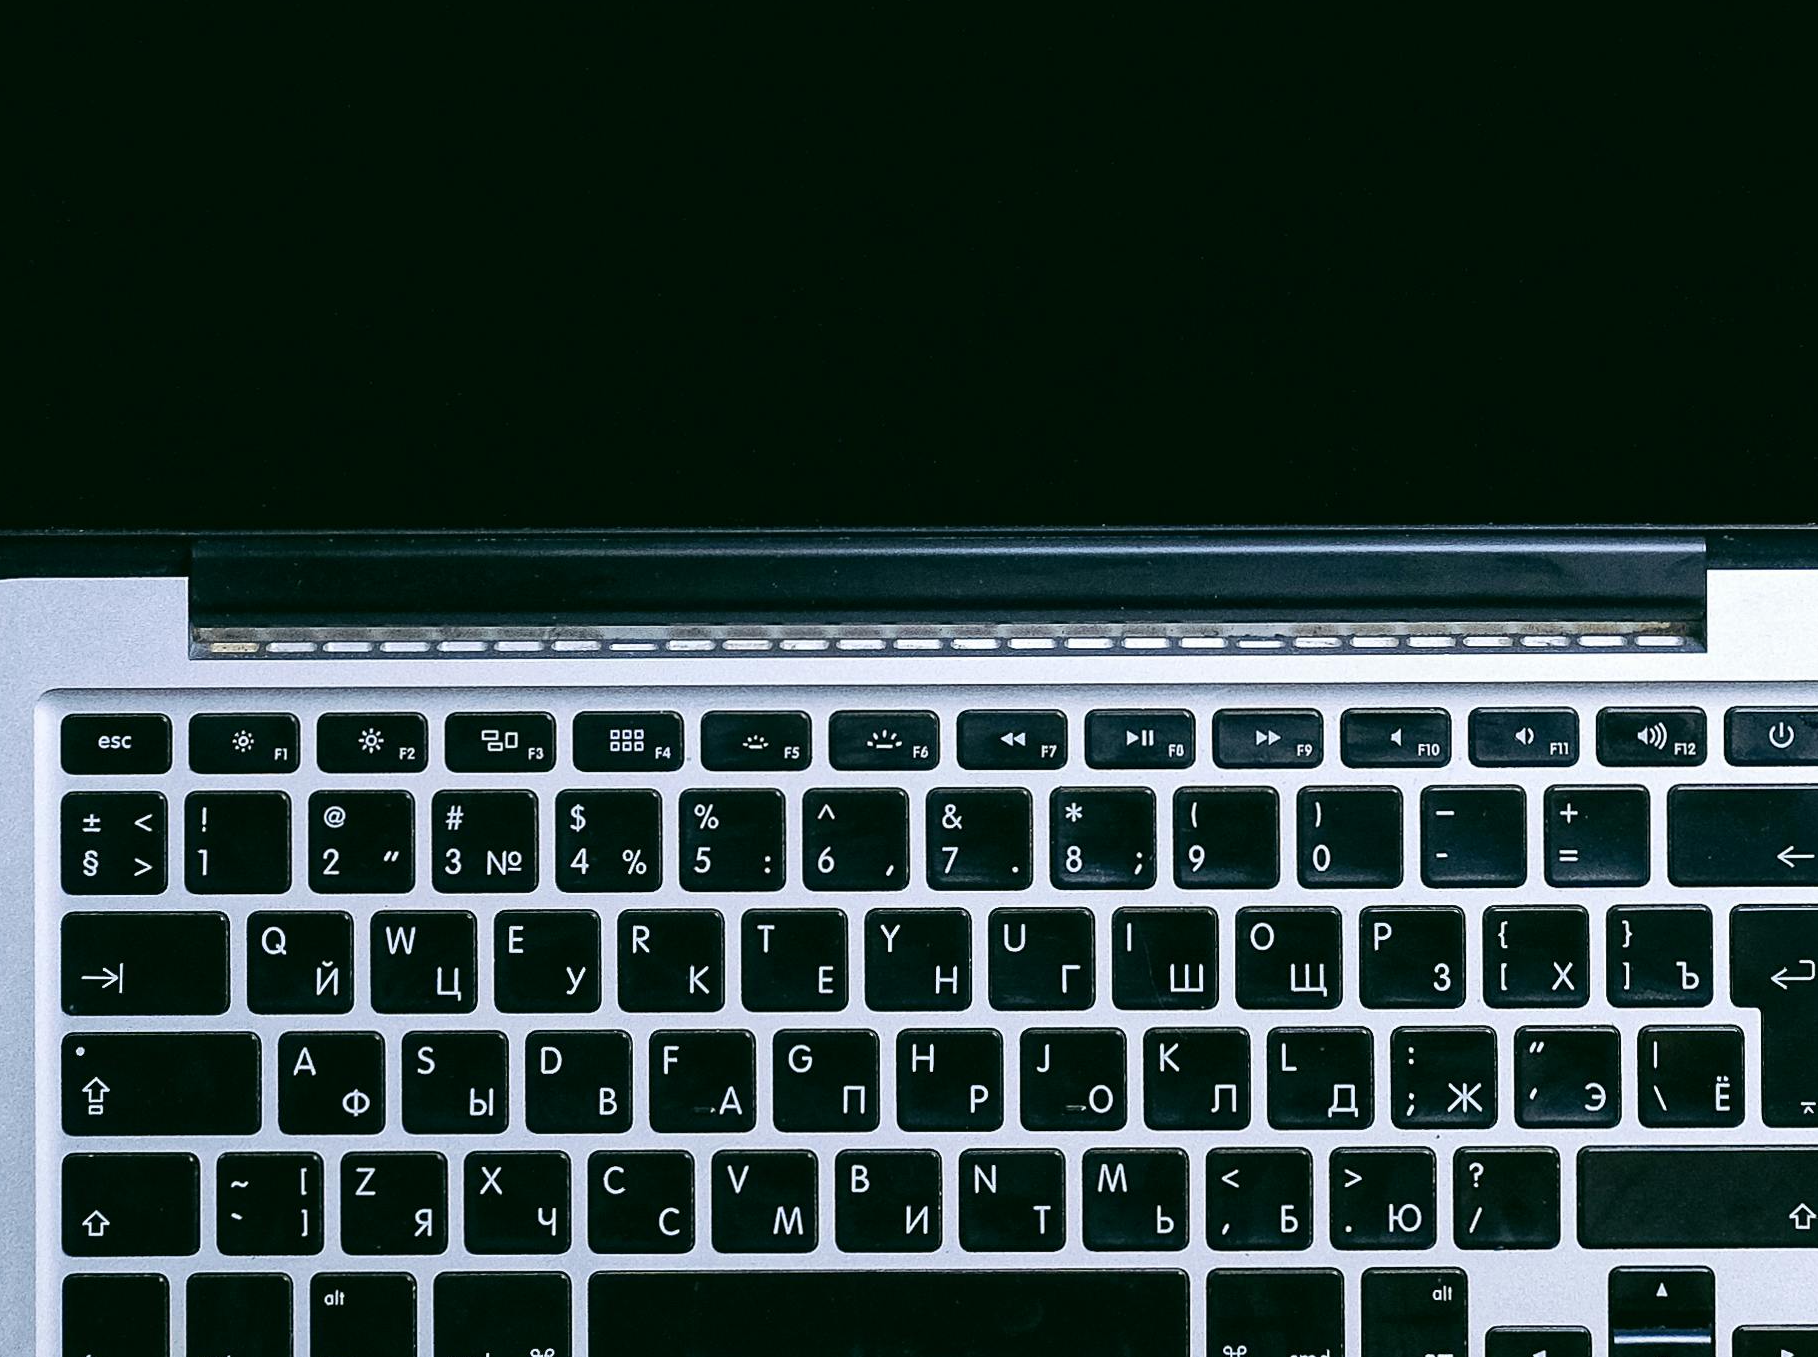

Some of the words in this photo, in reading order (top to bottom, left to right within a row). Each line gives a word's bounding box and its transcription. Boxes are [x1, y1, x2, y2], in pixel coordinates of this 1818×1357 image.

[99, 736, 131, 748] esc
[275, 748, 287, 760] F1
[400, 748, 415, 759] F2
[529, 748, 543, 759] F3
[655, 747, 671, 759] F4
[785, 747, 799, 759] F5
[913, 746, 928, 758] F6
[1042, 745, 1057, 757] F7
[1297, 744, 1312, 756] F9
[1418, 744, 1440, 756] F10
[1550, 742, 1568, 755] F11
[1675, 743, 1696, 755] F12
[198, 849, 207, 875] 1
[323, 849, 339, 875] 2
[445, 848, 461, 874] 3
[571, 848, 589, 874] 4
[694, 847, 710, 873] 5
[818, 847, 834, 873] 6
[942, 847, 958, 873] 7
[1065, 846, 1081, 873] 8
[1189, 845, 1205, 872] 9
[1313, 845, 1330, 871] 0
[262, 927, 286, 955] Q
[386, 927, 415, 954] W
[509, 926, 523, 953] E
[633, 925, 649, 953] R
[881, 925, 900, 952] Y
[1004, 924, 1025, 952] U
[317, 961, 338, 995] Й
[437, 967, 461, 1001] Ц
[1170, 964, 1203, 992] Ш
[1291, 964, 1327, 997] Щ
[1676, 962, 1699, 989] Ъ
[294, 1047, 316, 1075] A
[418, 1047, 435, 1074] S
[541, 1047, 562, 1074] D
[664, 1046, 679, 1074] F
[789, 1045, 812, 1072] G
[1037, 1044, 1049, 1072] J
[1282, 1043, 1297, 1071] L
[343, 1089, 370, 1116] Ф
[470, 1088, 493, 1116] Ы
[1328, 1084, 1358, 1117] Д
[1448, 1083, 1482, 1112] Ж
[1585, 1083, 1606, 1111] Э
[1716, 1076, 1730, 1111] Ё
[356, 1168, 375, 1195] Z
[480, 1167, 502, 1194] X
[728, 1165, 749, 1193] V
[975, 1165, 996, 1193] N
[415, 1209, 432, 1236] Я
[538, 1208, 556, 1236] Ч
[906, 1206, 928, 1234] И
[1281, 1205, 1298, 1233] Б
[1389, 1204, 1421, 1232] Ю
[324, 1290, 344, 1305] alt
[1433, 1285, 1453, 1302] alt
